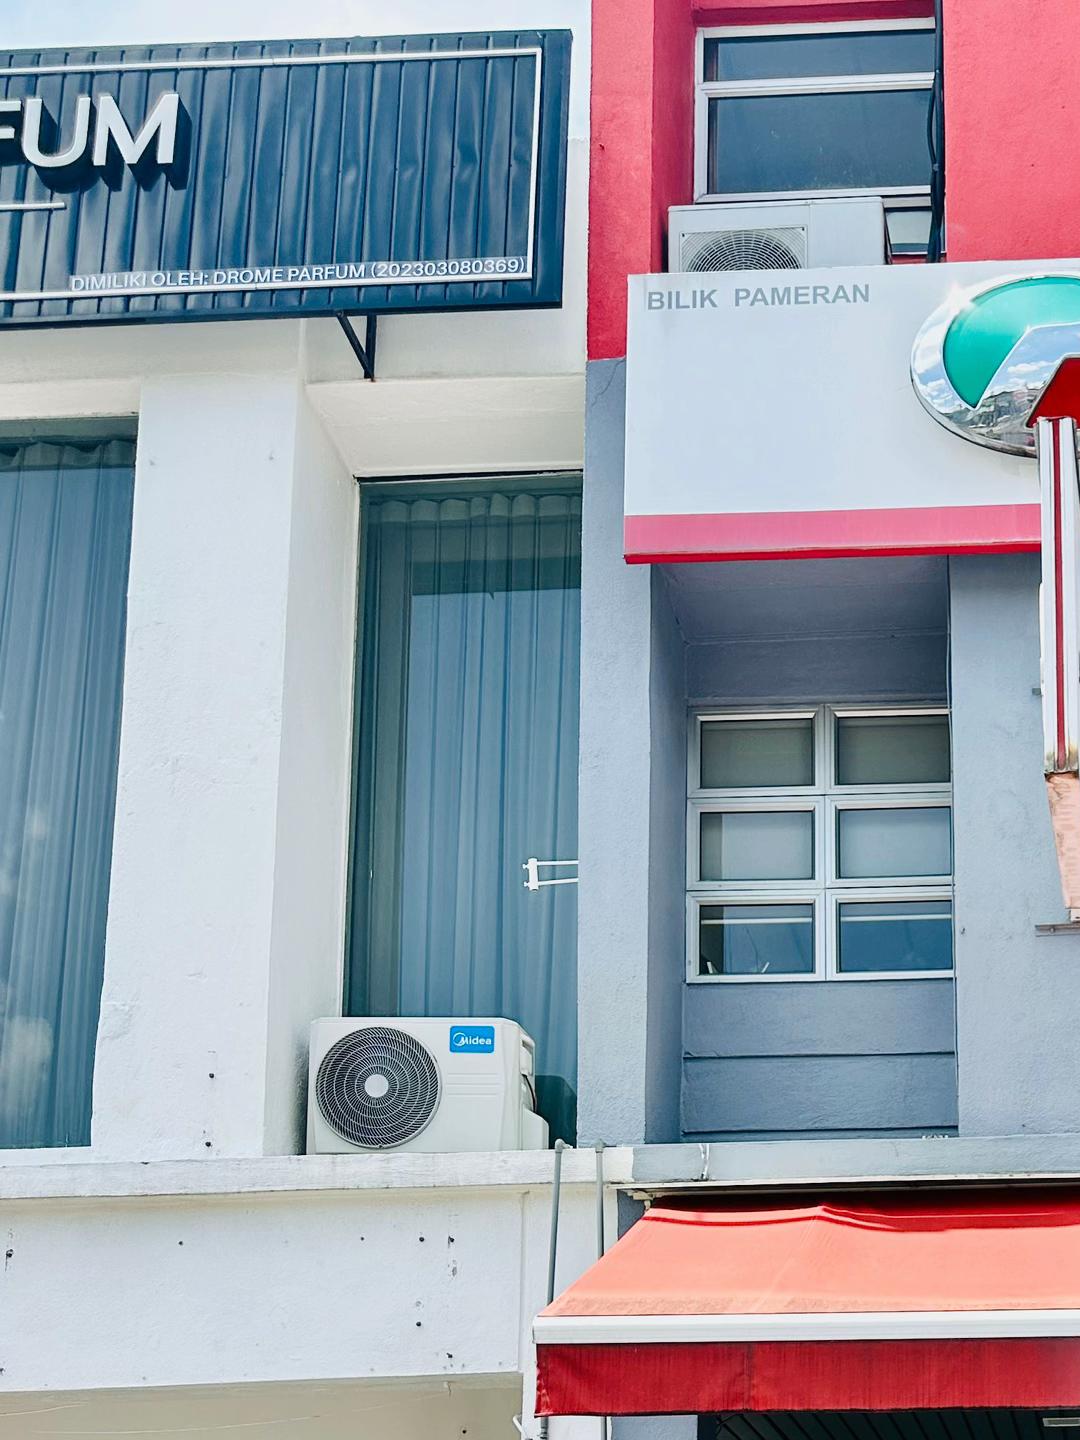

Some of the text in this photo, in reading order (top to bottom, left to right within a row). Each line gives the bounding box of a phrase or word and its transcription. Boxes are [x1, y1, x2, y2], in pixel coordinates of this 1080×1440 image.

[71, 256, 525, 291] DIMILIKI OLEH: DROME PARFUM (202303080369)
[647, 283, 871, 310] BILIK PAMERAN
[453, 1032, 492, 1046] Midea
